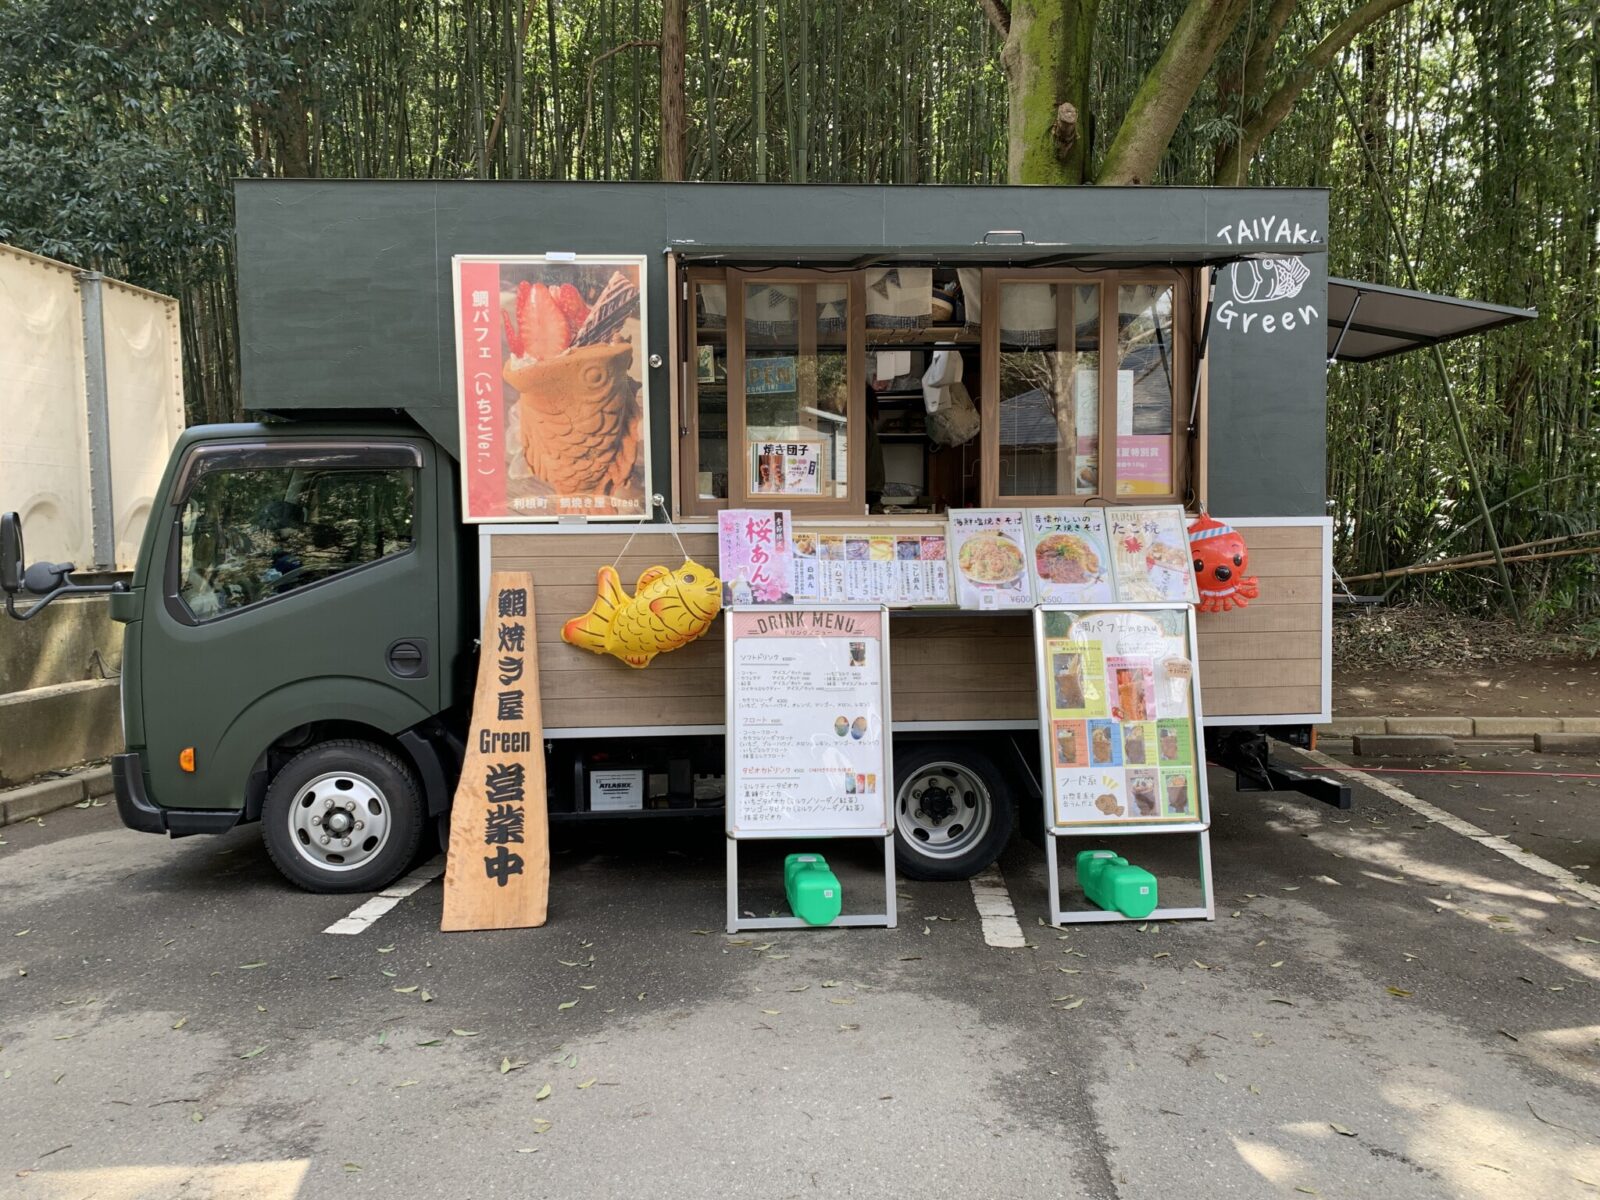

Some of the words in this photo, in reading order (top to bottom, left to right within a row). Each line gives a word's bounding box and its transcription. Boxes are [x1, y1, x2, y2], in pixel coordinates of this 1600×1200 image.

[1216, 300, 1318, 333] Green
[763, 444, 809, 456] 焼き団子
[1034, 523, 1102, 533] ソース焼きそば
[745, 517, 773, 584] 桜あん
[807, 566, 815, 589] 白あん
[834, 562, 843, 593] ハムマヨ
[912, 563, 921, 590] こしあん
[1010, 595, 1031, 604] ¥600
[757, 611, 806, 634] DRINK
[812, 611, 856, 633] MENU
[498, 588, 527, 721] 鯛焼き屋
[740, 653, 779, 661] ソフトドリンク
[479, 728, 531, 754] Green
[1061, 775, 1097, 787] フード系
[484, 762, 526, 887] 営業中
